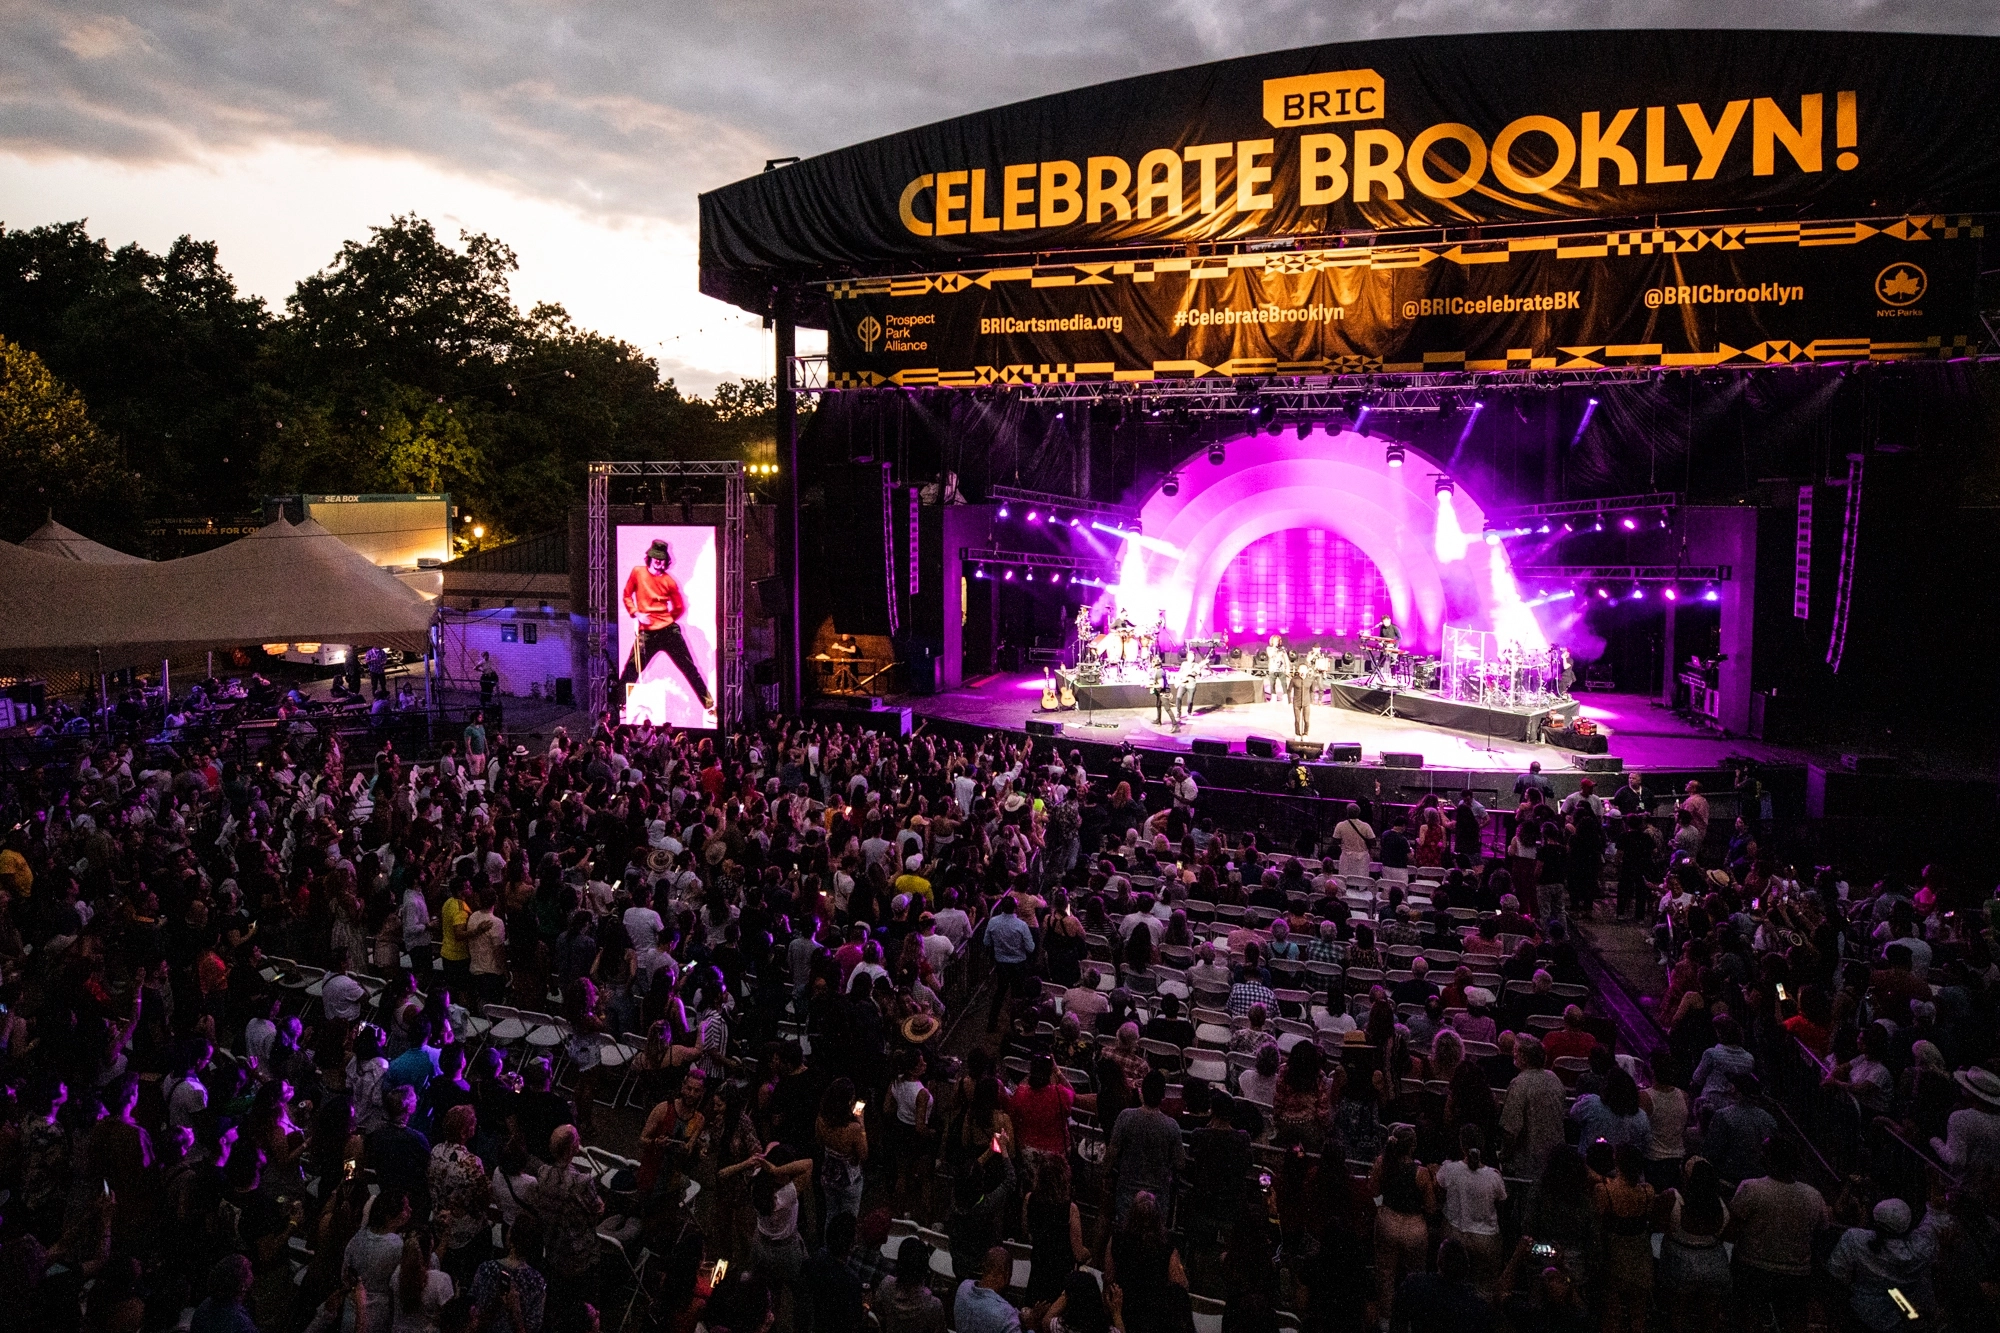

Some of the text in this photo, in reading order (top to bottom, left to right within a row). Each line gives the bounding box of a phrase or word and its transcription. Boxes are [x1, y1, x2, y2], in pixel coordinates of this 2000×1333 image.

[1283, 86, 1377, 121] BRIC
[899, 90, 1861, 237] CELEBRATE BROOKLYN!
[1644, 282, 1804, 309] @BRICbrooklyn
[1401, 290, 1581, 320] @BRICcelebrateBK
[1876, 308, 1924, 318] NYC Parks
[885, 314, 936, 326] Prospect
[1173, 304, 1346, 328] #CelebrateBrooklyn
[980, 314, 1123, 335] BRICartsmedia.org
[885, 327, 911, 339] Park
[884, 340, 928, 352] Alliance
[324, 495, 342, 503] SEA
[342, 495, 360, 503] BOX
[176, 527, 219, 536] THANKS
[219, 526, 240, 535] FOR
